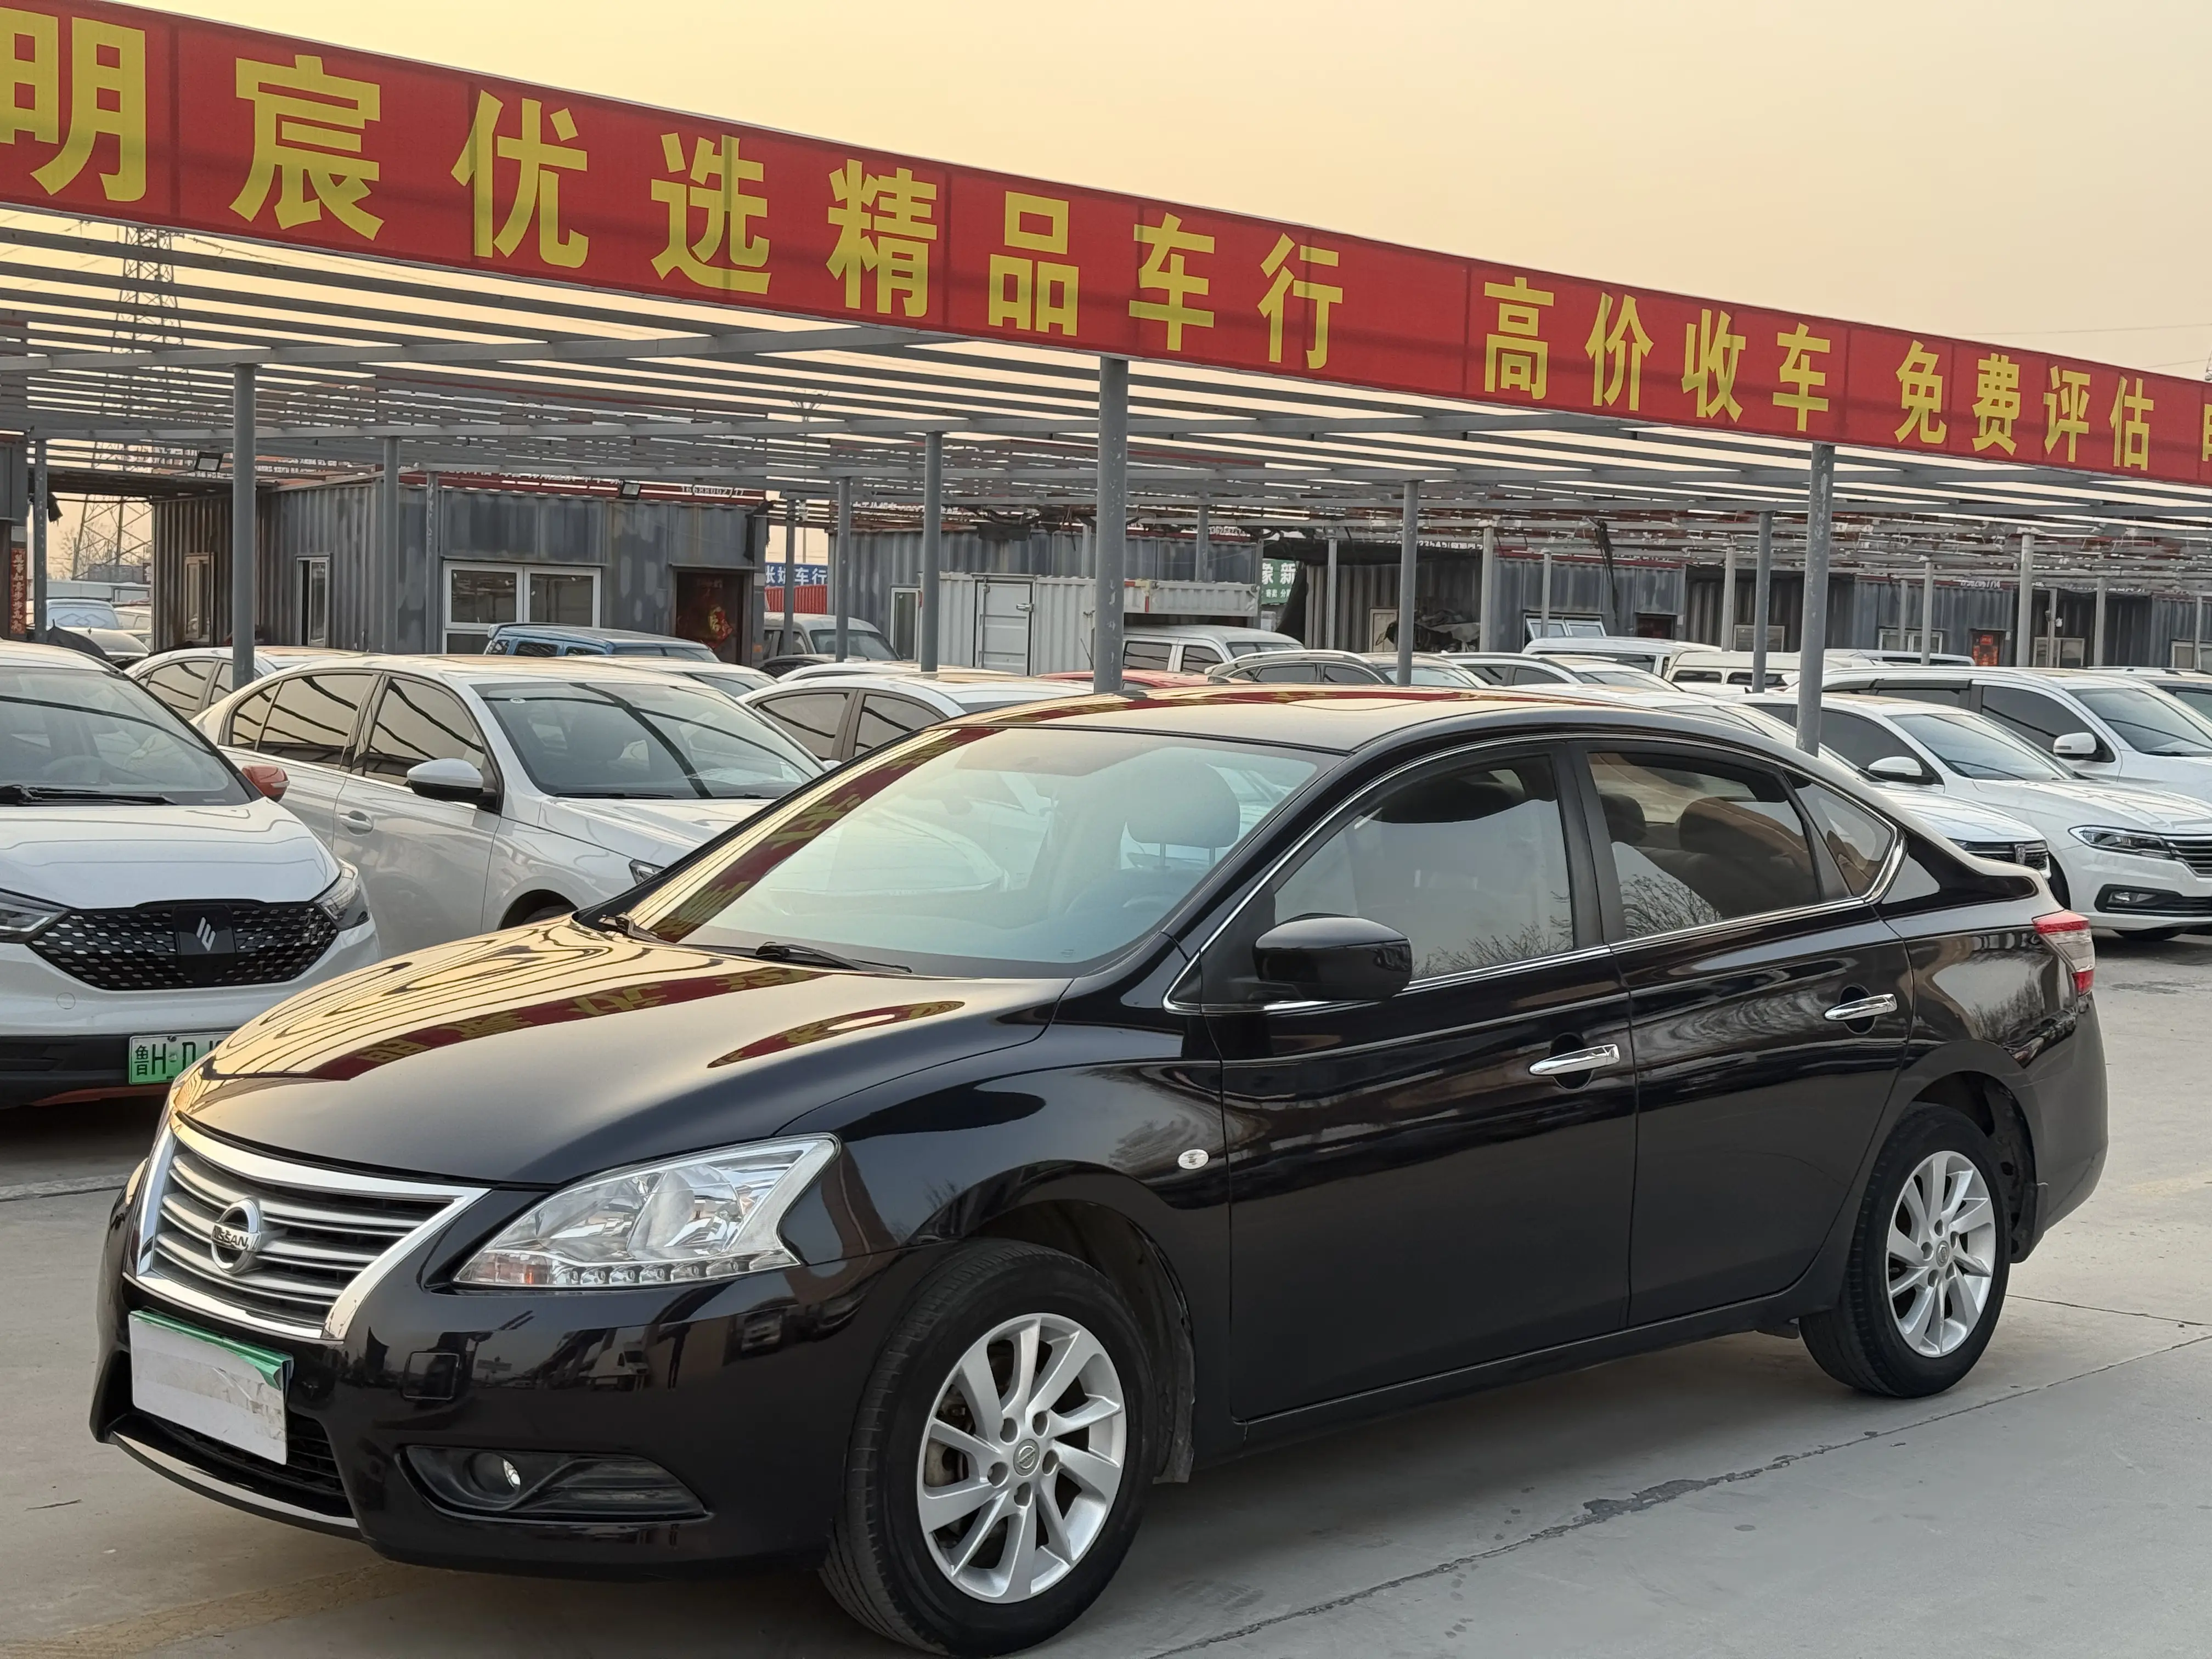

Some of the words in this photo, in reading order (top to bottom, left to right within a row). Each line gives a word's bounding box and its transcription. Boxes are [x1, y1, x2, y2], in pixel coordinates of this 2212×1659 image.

[0, 7, 1344, 369] 明宸优选精品车行
[1484, 276, 1831, 432] 高价收车
[1894, 339, 2155, 472] 免费评估
[212, 1224, 249, 1248] NISSAN
